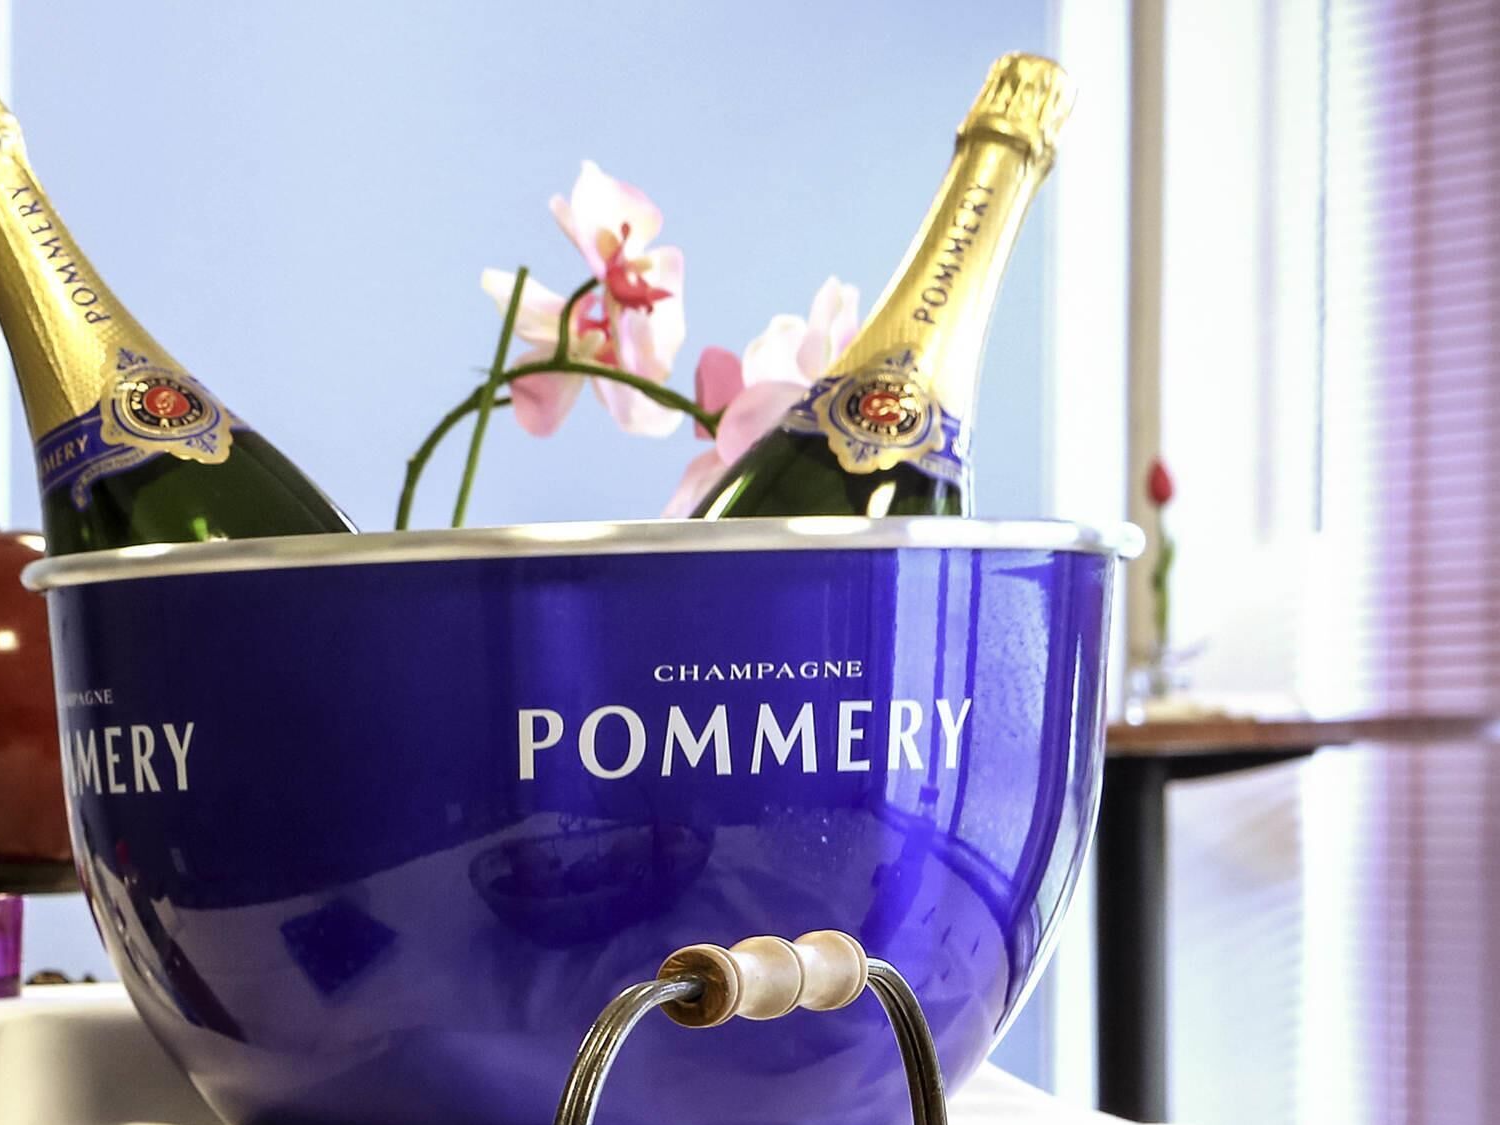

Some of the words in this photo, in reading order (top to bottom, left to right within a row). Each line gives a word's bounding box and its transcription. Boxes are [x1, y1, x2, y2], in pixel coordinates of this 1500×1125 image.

[6, 186, 111, 324] POMMERY
[913, 184, 995, 325] POMMERY
[654, 660, 863, 682] CHAMPAGNE
[518, 698, 973, 780] POMMERY
